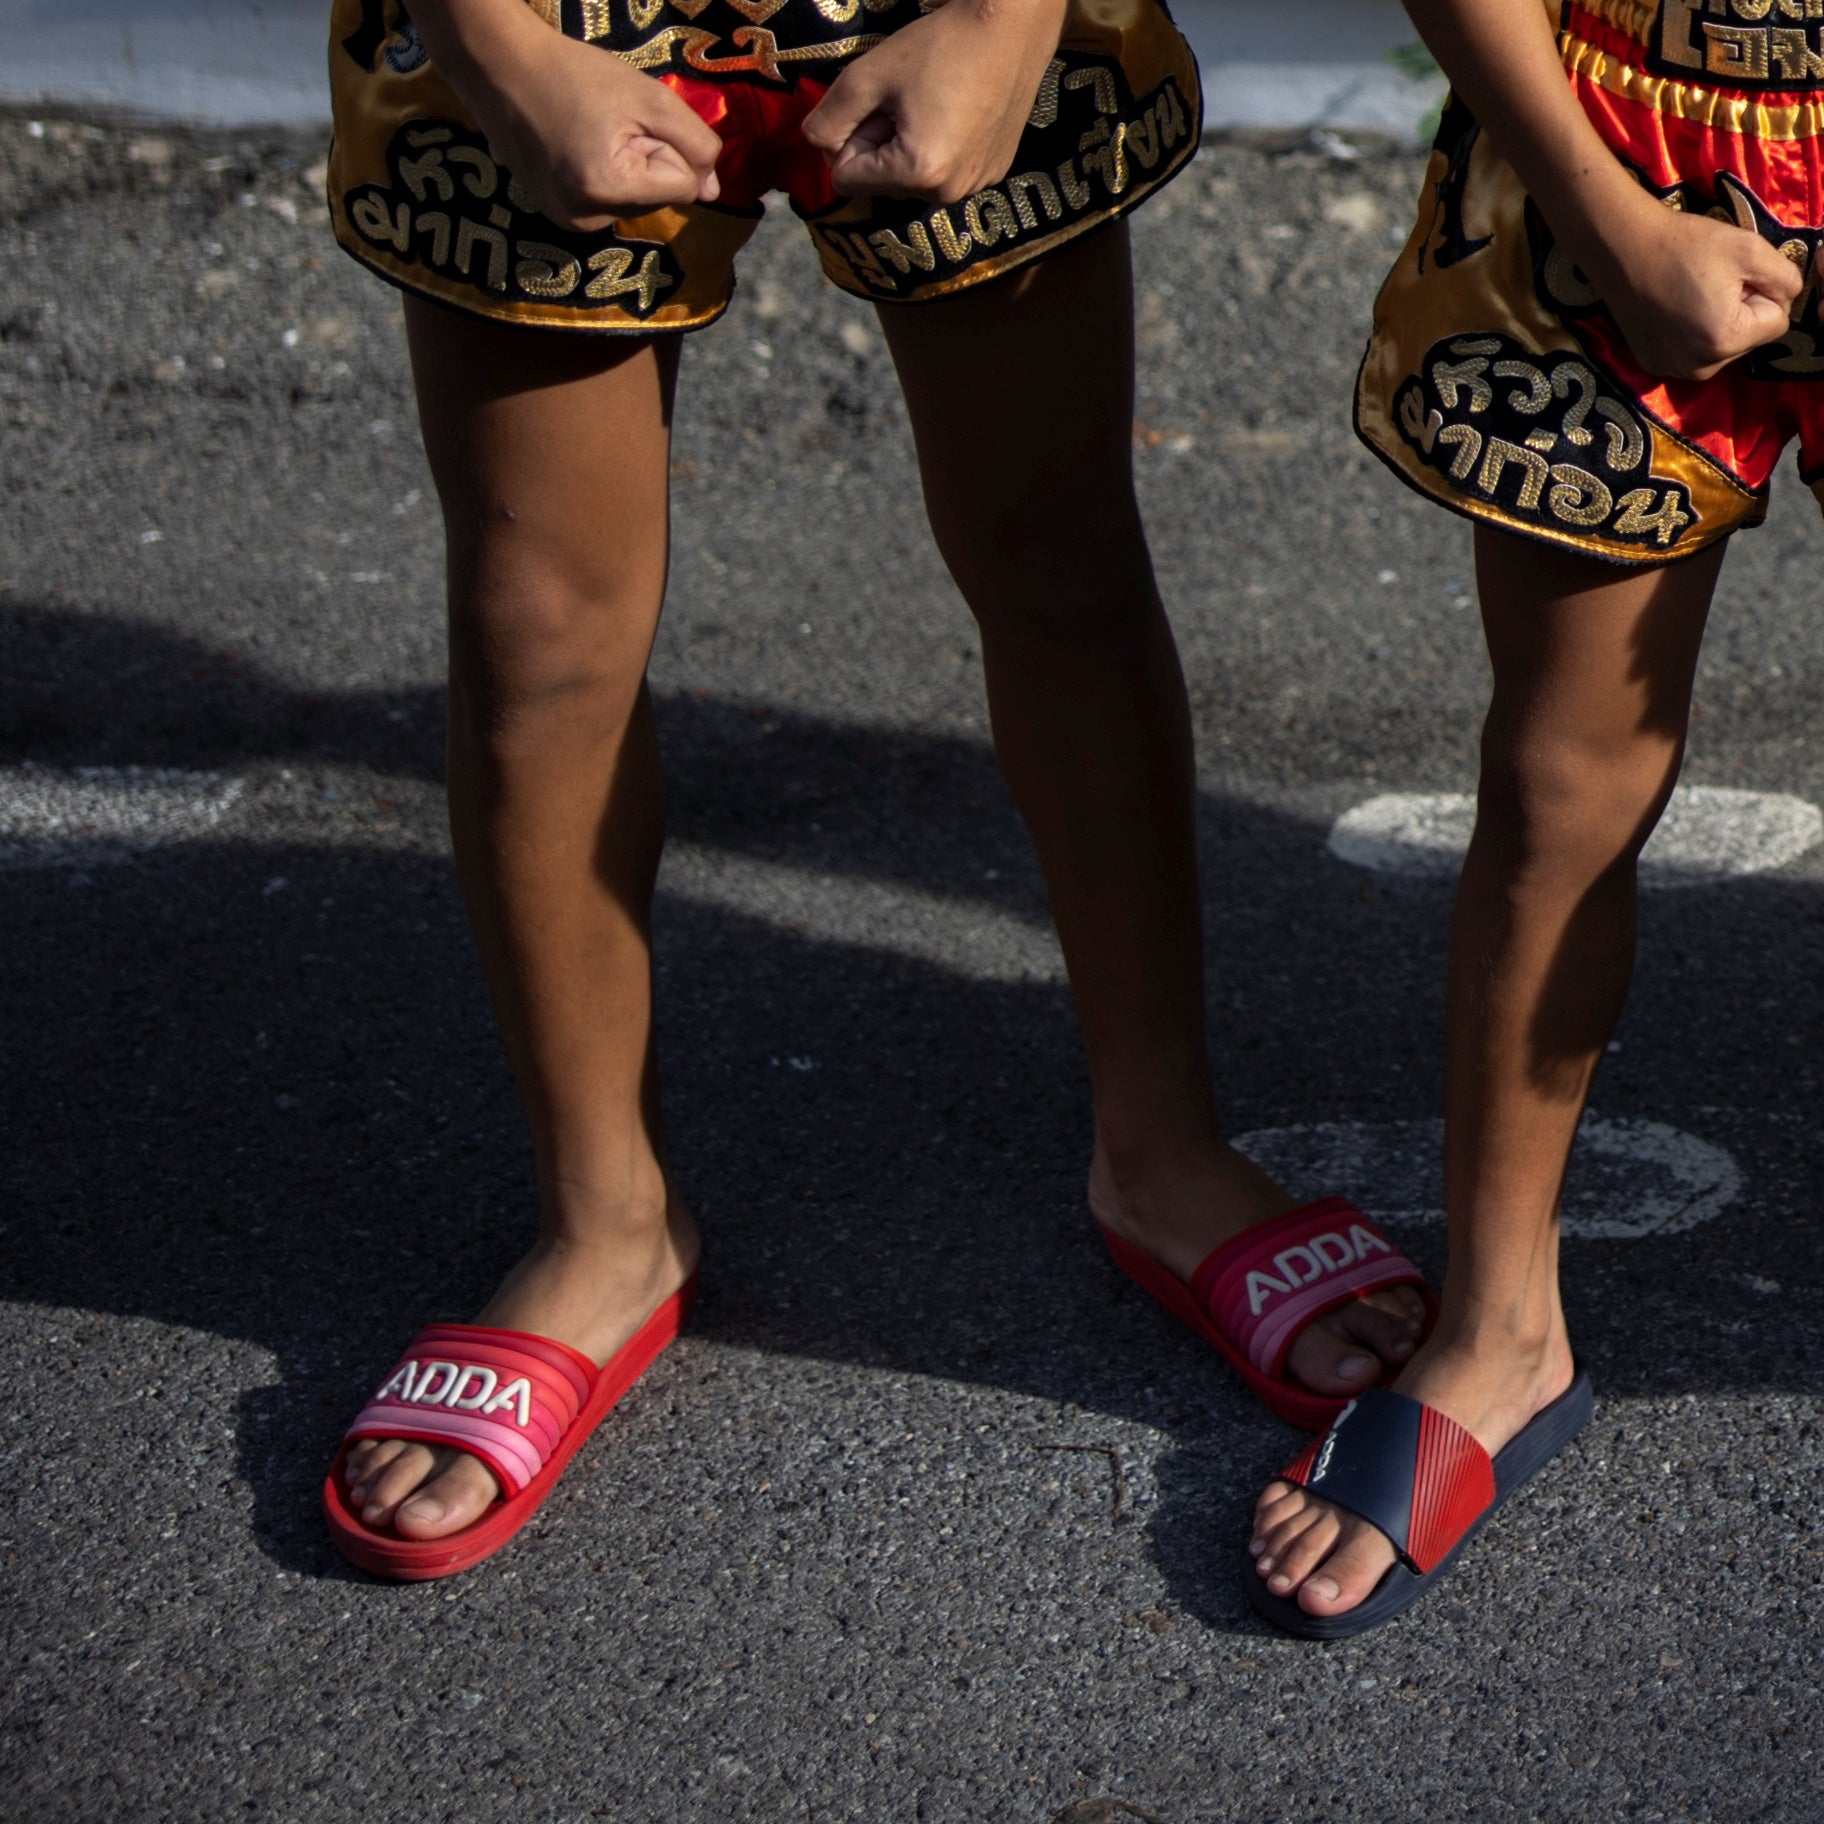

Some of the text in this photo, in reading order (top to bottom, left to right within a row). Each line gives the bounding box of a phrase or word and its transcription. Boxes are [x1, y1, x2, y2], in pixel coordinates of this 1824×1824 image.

[351, 188, 676, 312] มาก่อน
[1400, 384, 1690, 543] มาก่อน
[1432, 338, 1643, 471] หัวใจ
[1246, 1223, 1392, 1316] ADDA
[375, 1359, 531, 1427] ADDA
